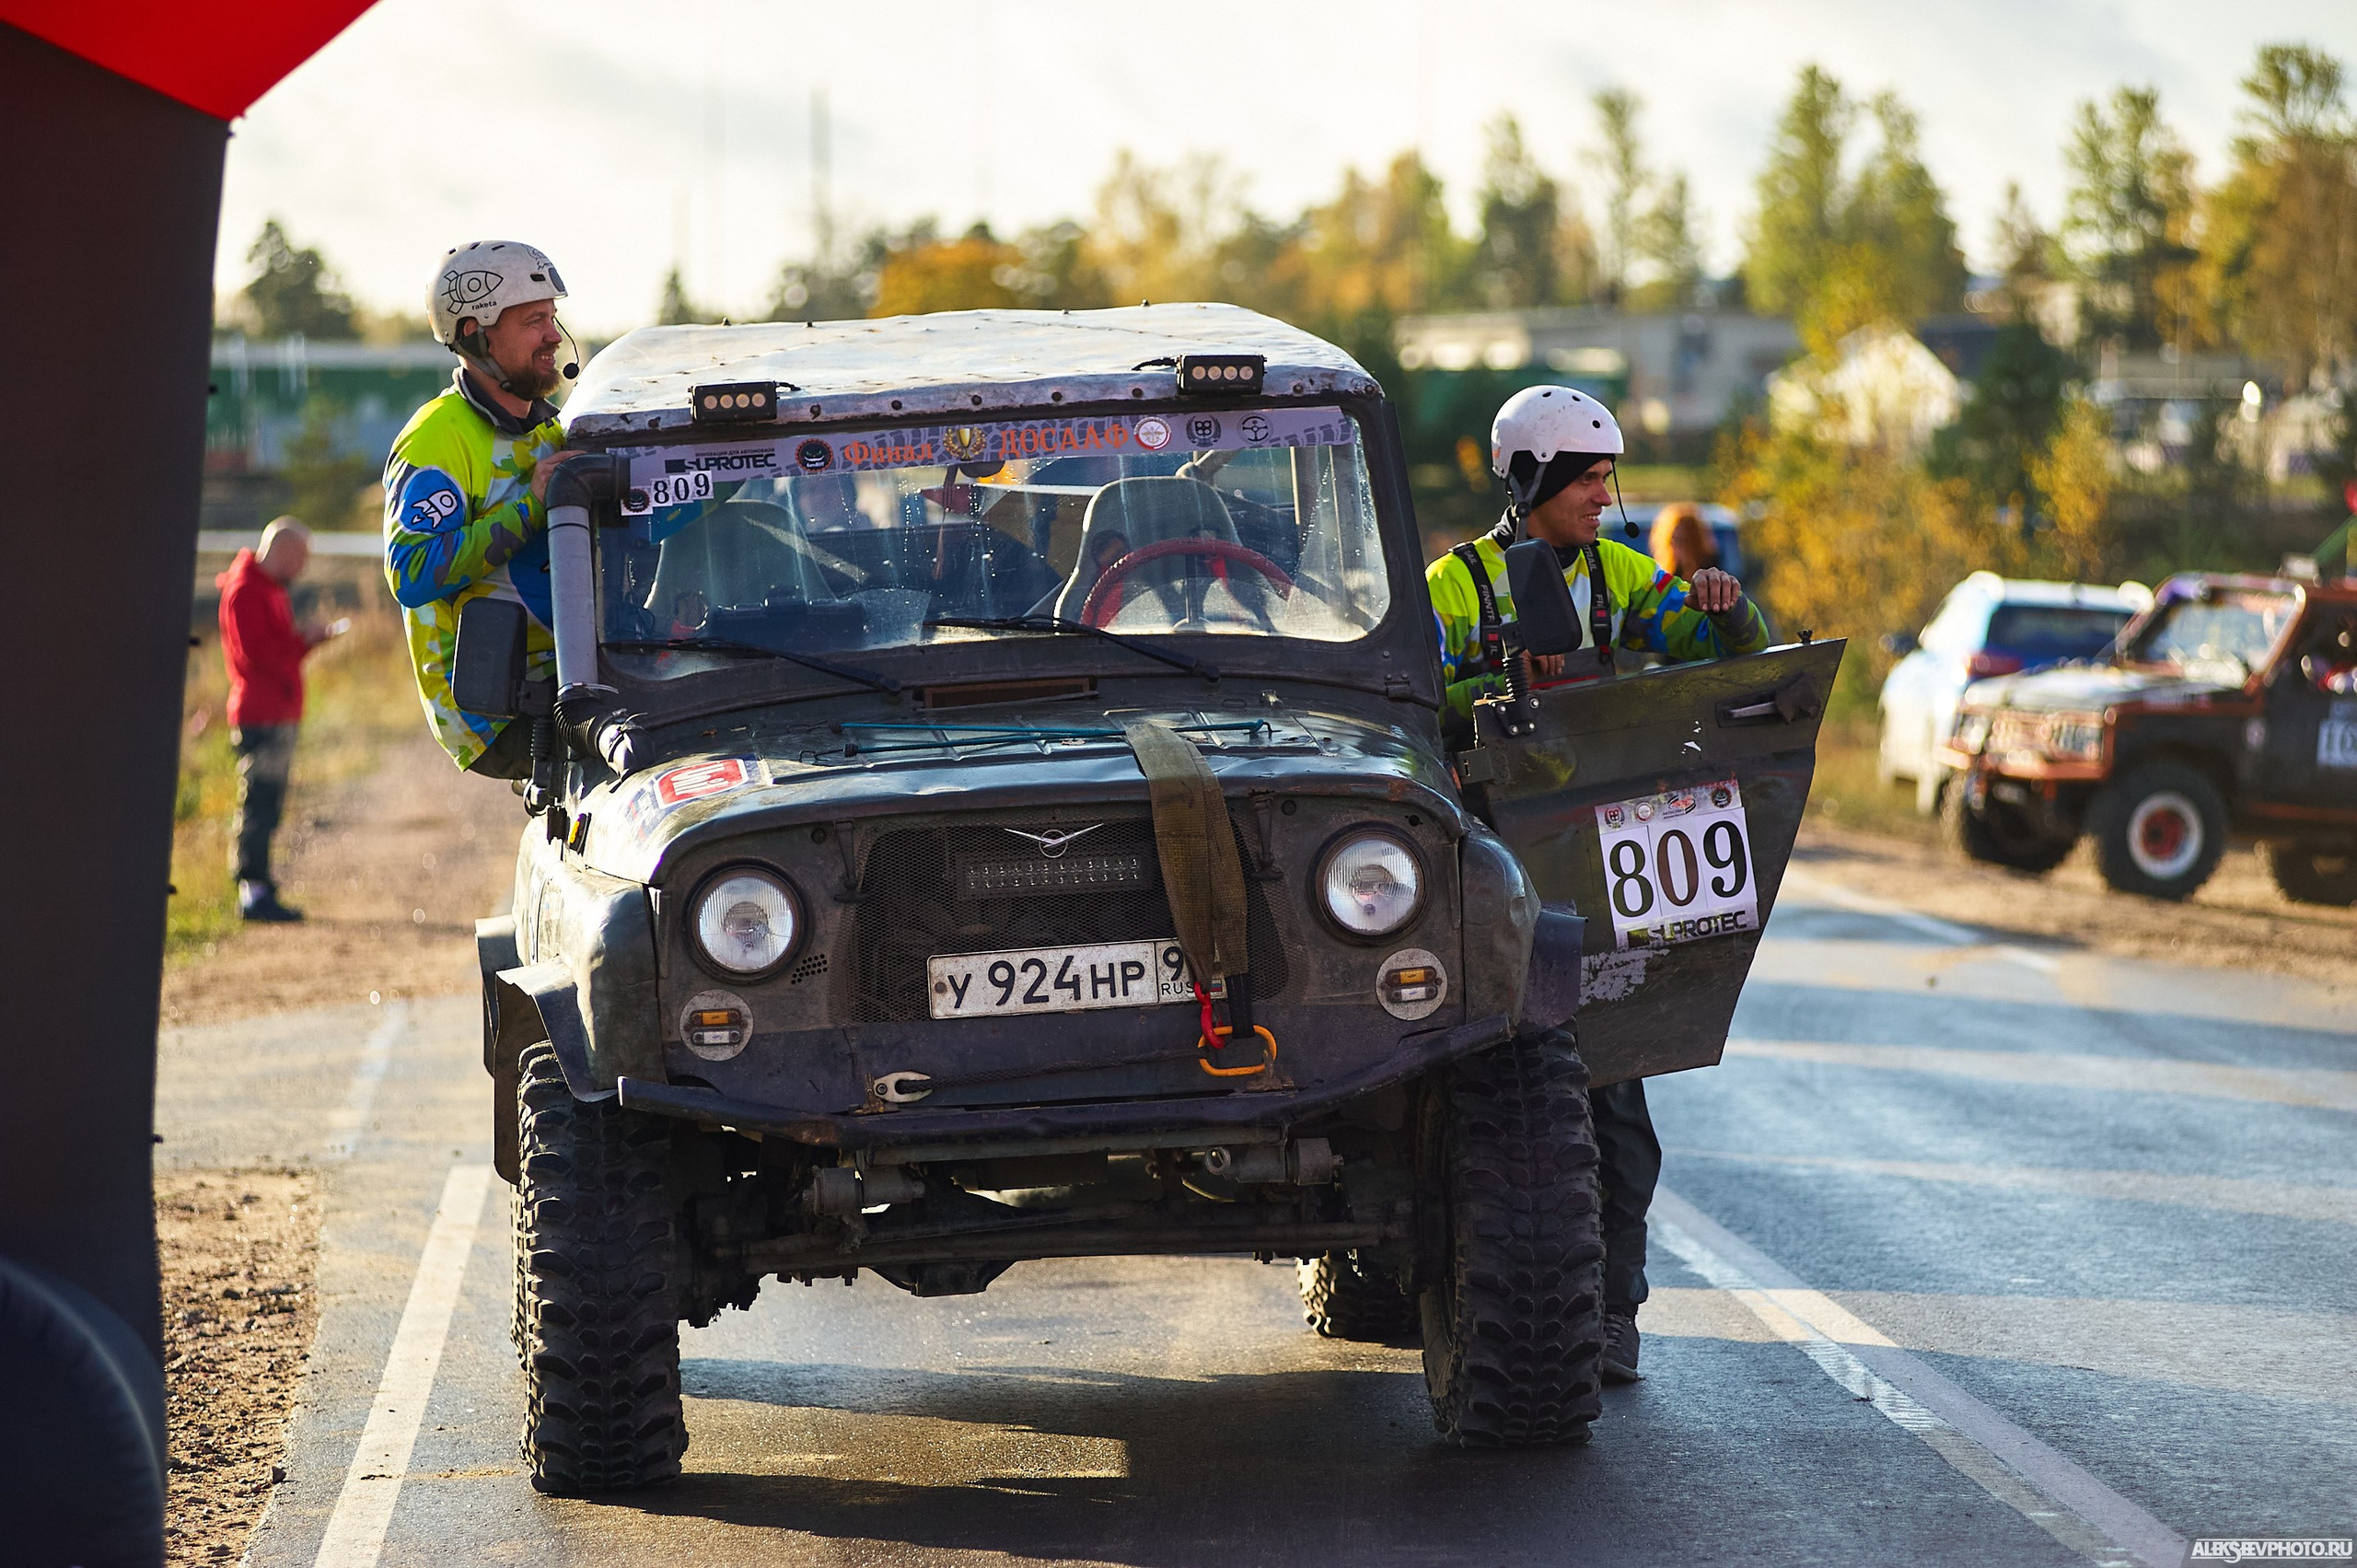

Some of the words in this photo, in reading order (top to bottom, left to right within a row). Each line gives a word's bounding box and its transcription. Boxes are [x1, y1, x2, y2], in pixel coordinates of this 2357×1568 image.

[471, 300, 497, 310] raketa
[844, 440, 933, 465] Финал
[998, 424, 1129, 460] ДОСААФ
[685, 453, 777, 470] SUPROTEC
[654, 473, 710, 504] 809
[1609, 820, 1747, 918] 809
[1647, 911, 1747, 941] SUPROTEC
[1161, 981, 1195, 995] RUS
